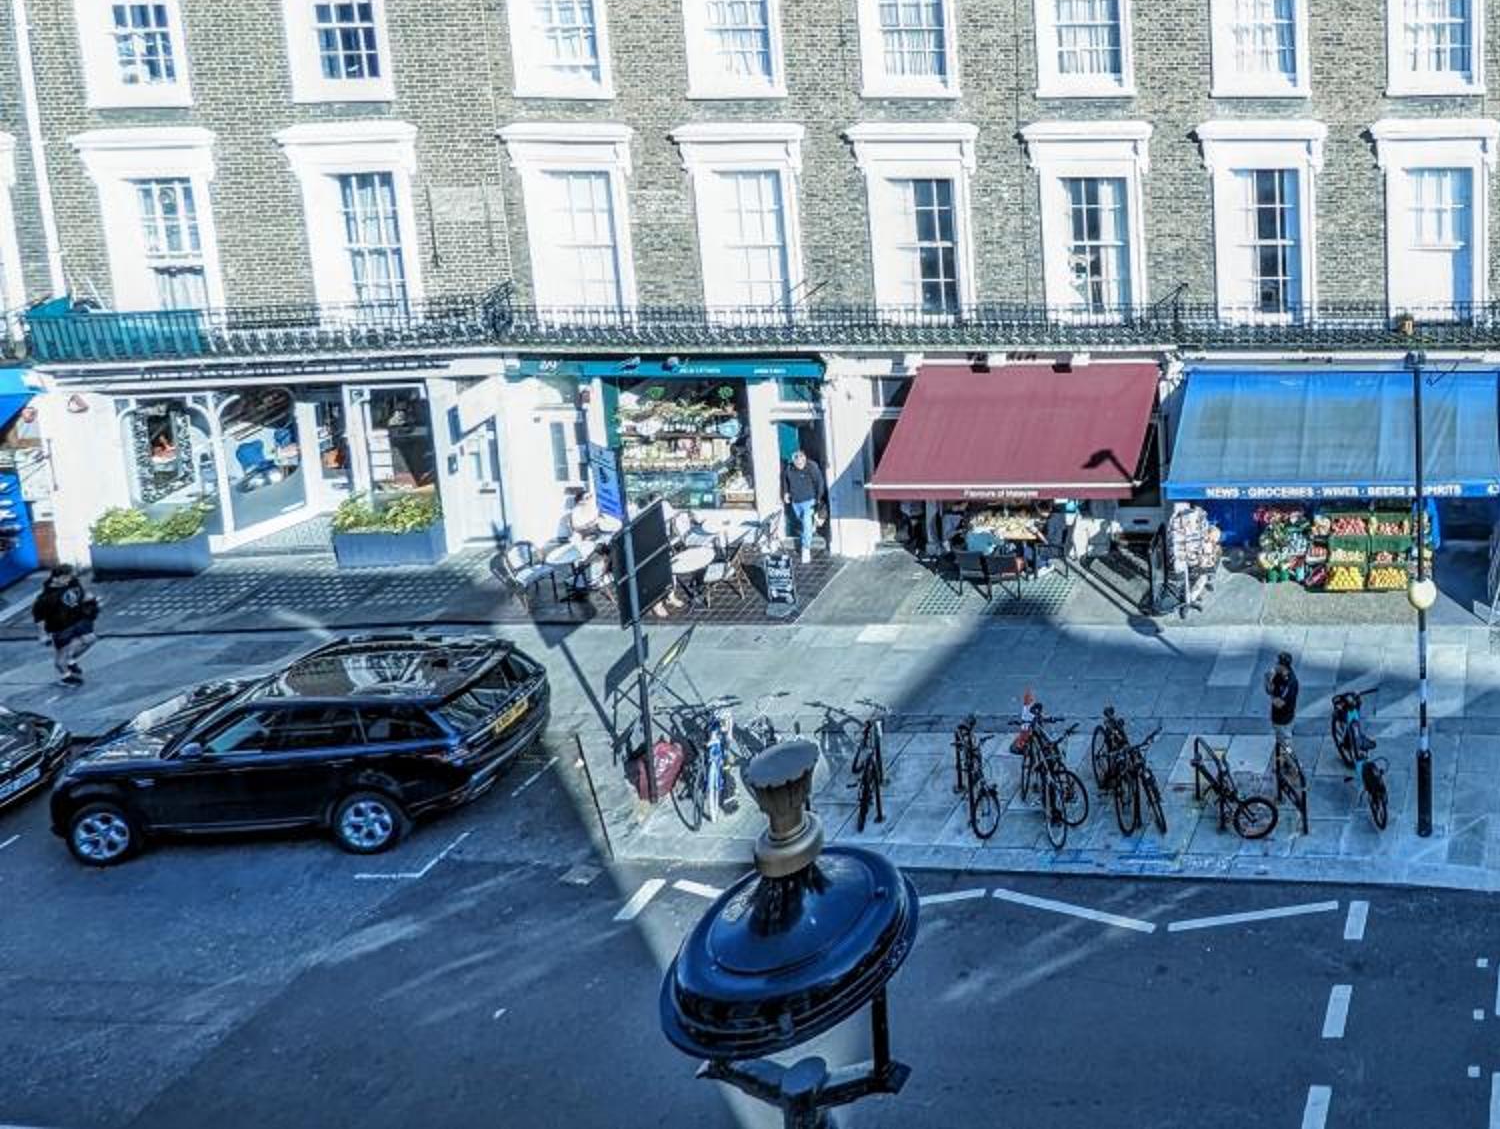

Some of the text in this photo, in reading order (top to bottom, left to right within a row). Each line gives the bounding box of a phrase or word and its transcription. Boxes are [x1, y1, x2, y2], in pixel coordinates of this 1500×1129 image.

[1205, 486, 1240, 499] NEWS
[1247, 486, 1315, 499] GROCERIES
[1367, 485, 1405, 497] BEERS
